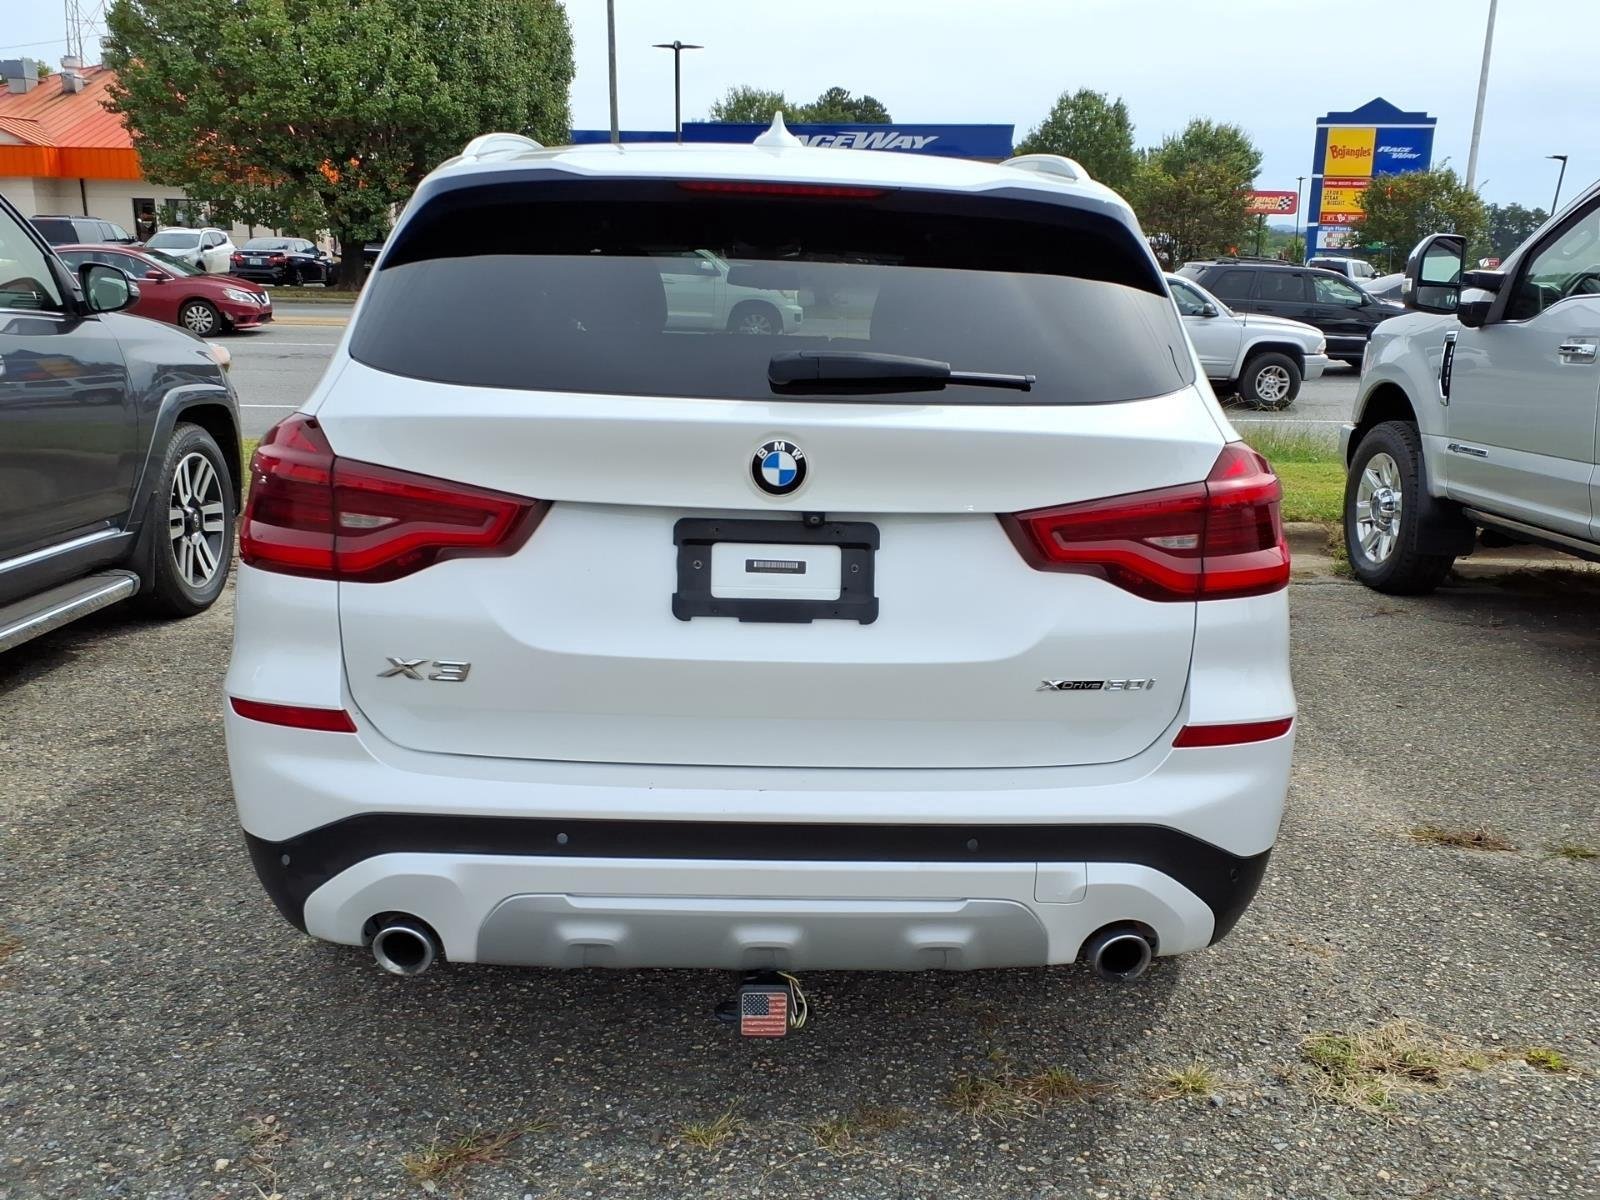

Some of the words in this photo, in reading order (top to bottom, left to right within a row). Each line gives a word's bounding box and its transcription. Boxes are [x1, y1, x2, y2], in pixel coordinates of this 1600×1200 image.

[1330, 144, 1372, 160] Bojangles
[757, 441, 803, 461] BMW
[376, 656, 471, 682] X3
